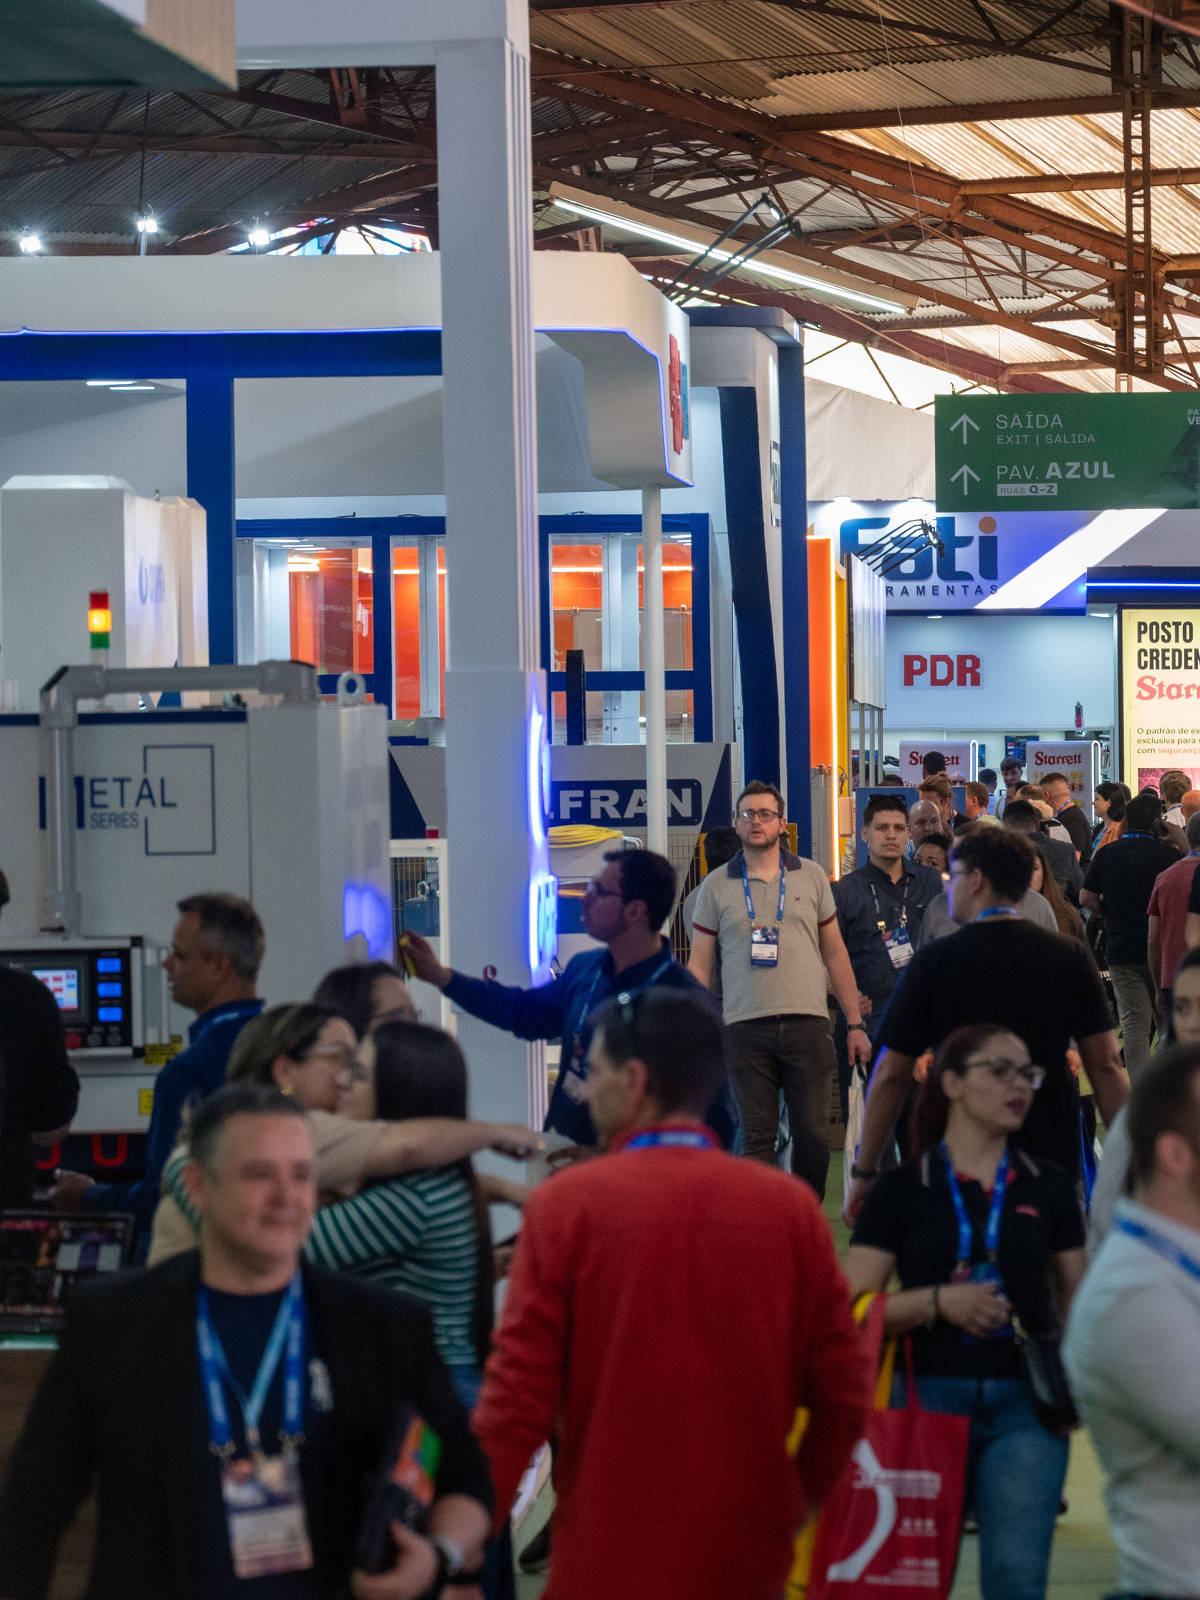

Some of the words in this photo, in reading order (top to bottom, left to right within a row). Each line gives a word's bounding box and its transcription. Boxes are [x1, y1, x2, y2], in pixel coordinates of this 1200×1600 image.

[996, 411, 1063, 429] SAÍDA
[997, 435, 1029, 445] EXIT
[1045, 433, 1096, 444] SALIDA
[997, 465, 1039, 479] PAV.
[1046, 461, 1115, 479] AZUL
[1137, 621, 1193, 643] POSTO
[904, 655, 981, 686] PDR
[1146, 727, 1175, 736] padrão
[1178, 727, 1189, 735] de
[1137, 737, 1175, 745] exclusiva
[1177, 738, 1196, 746] para
[1034, 751, 1082, 766] Starrett
[550, 788, 692, 819] FRAN
[90, 812, 139, 829] SERIES
